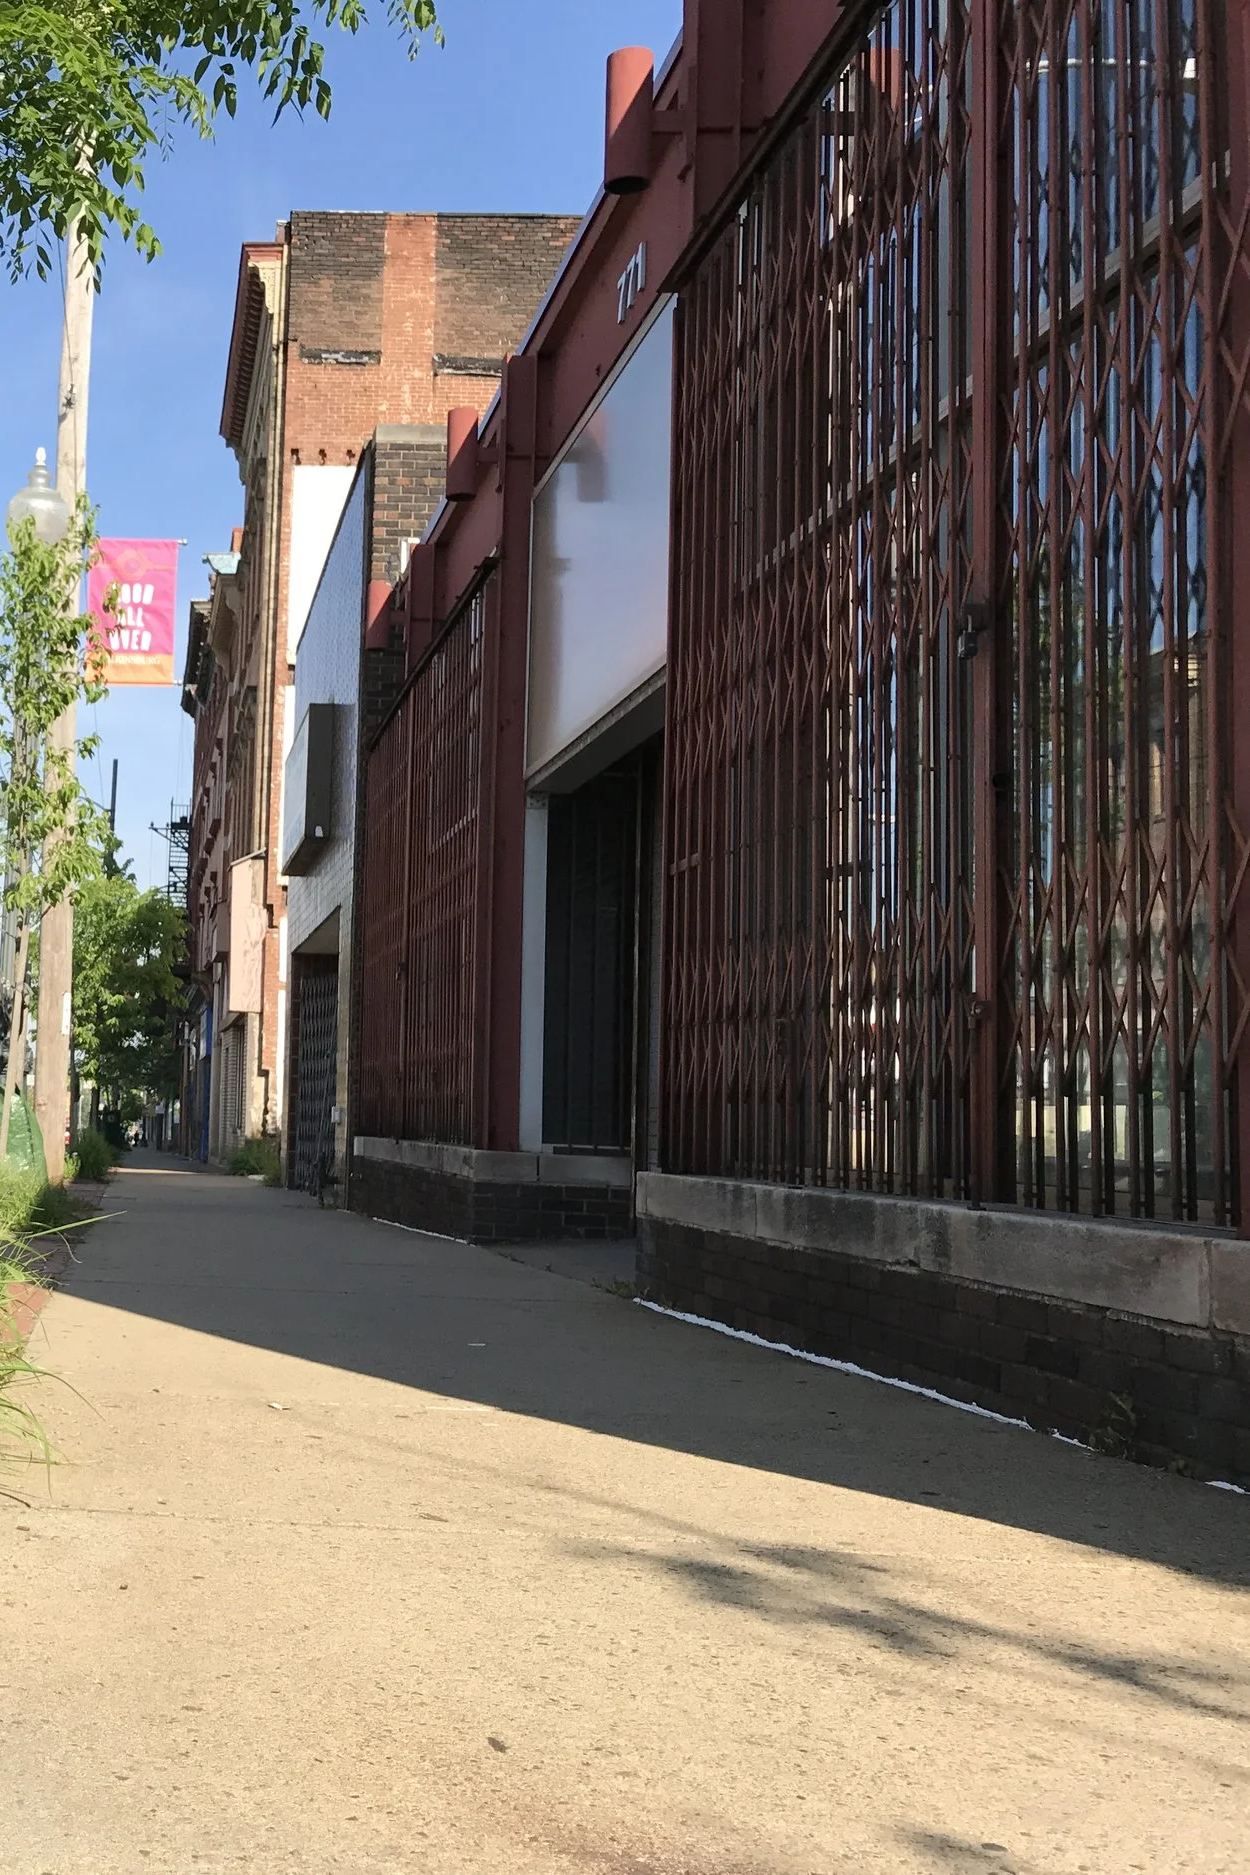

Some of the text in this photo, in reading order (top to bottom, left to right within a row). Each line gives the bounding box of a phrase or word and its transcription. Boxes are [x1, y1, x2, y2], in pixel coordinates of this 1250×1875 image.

[617, 242, 647, 324] 771
[111, 583, 154, 605] OOD
[109, 629, 152, 651] OVER
